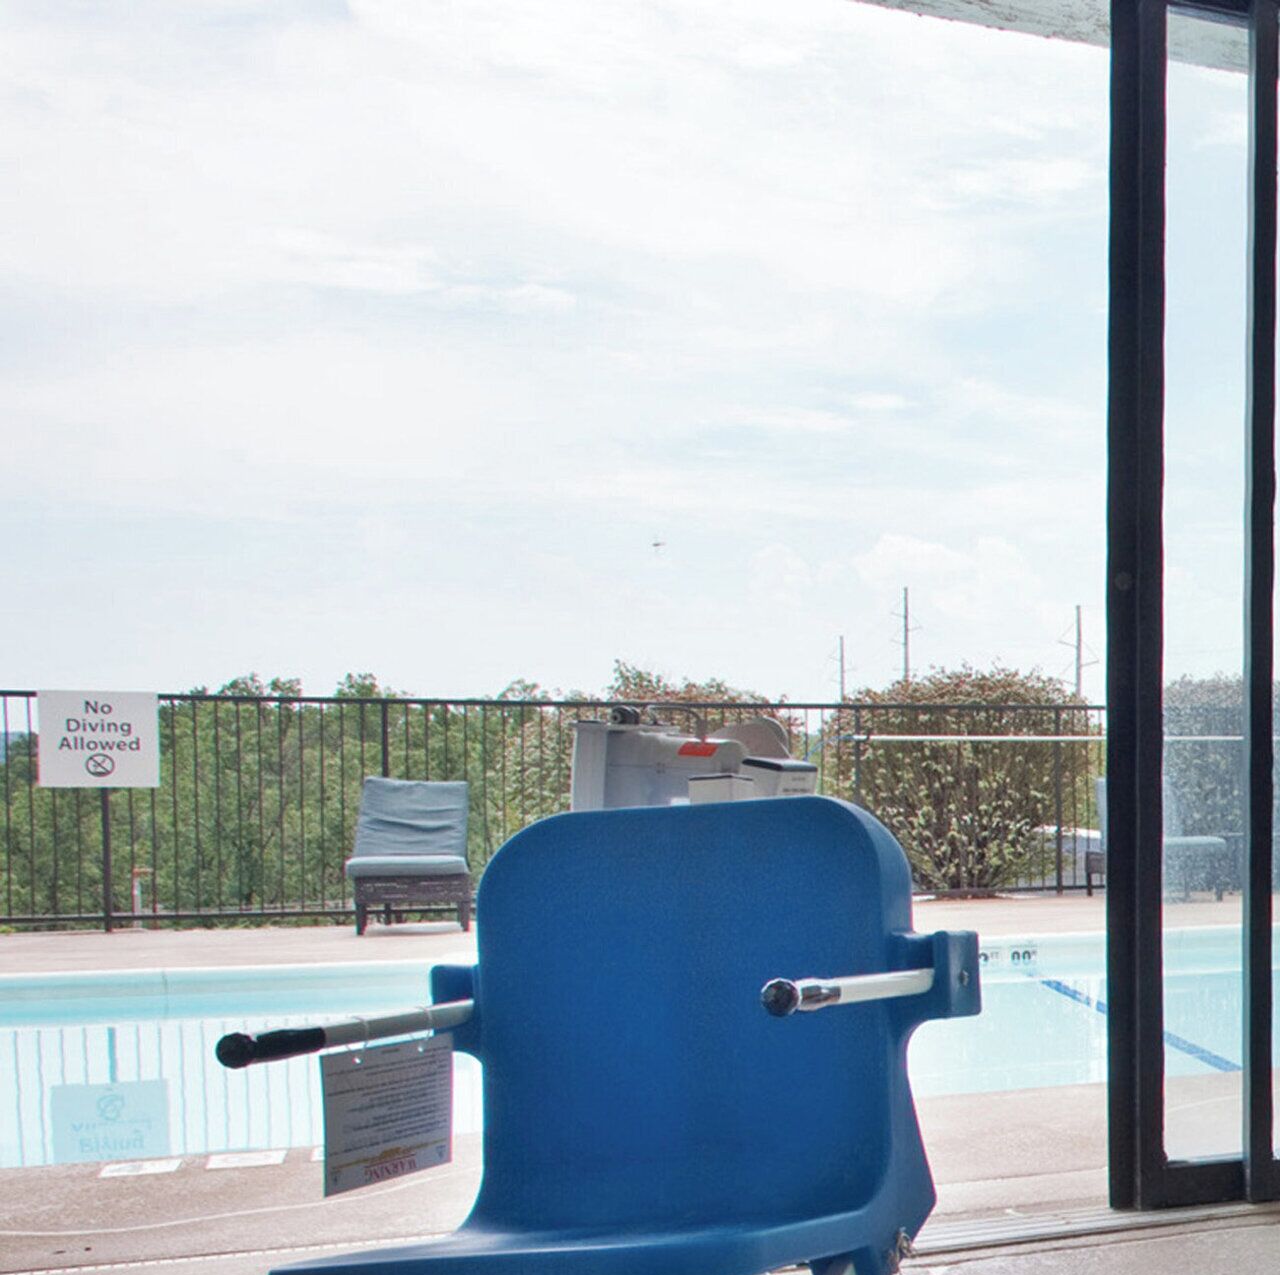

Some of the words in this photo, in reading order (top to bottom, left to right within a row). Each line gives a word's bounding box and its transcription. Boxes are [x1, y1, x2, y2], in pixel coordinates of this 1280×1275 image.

[84, 701, 113, 715] No
[66, 718, 132, 736] Diving
[58, 737, 141, 751] Allowed
[364, 1159, 417, 1182] WARNING
